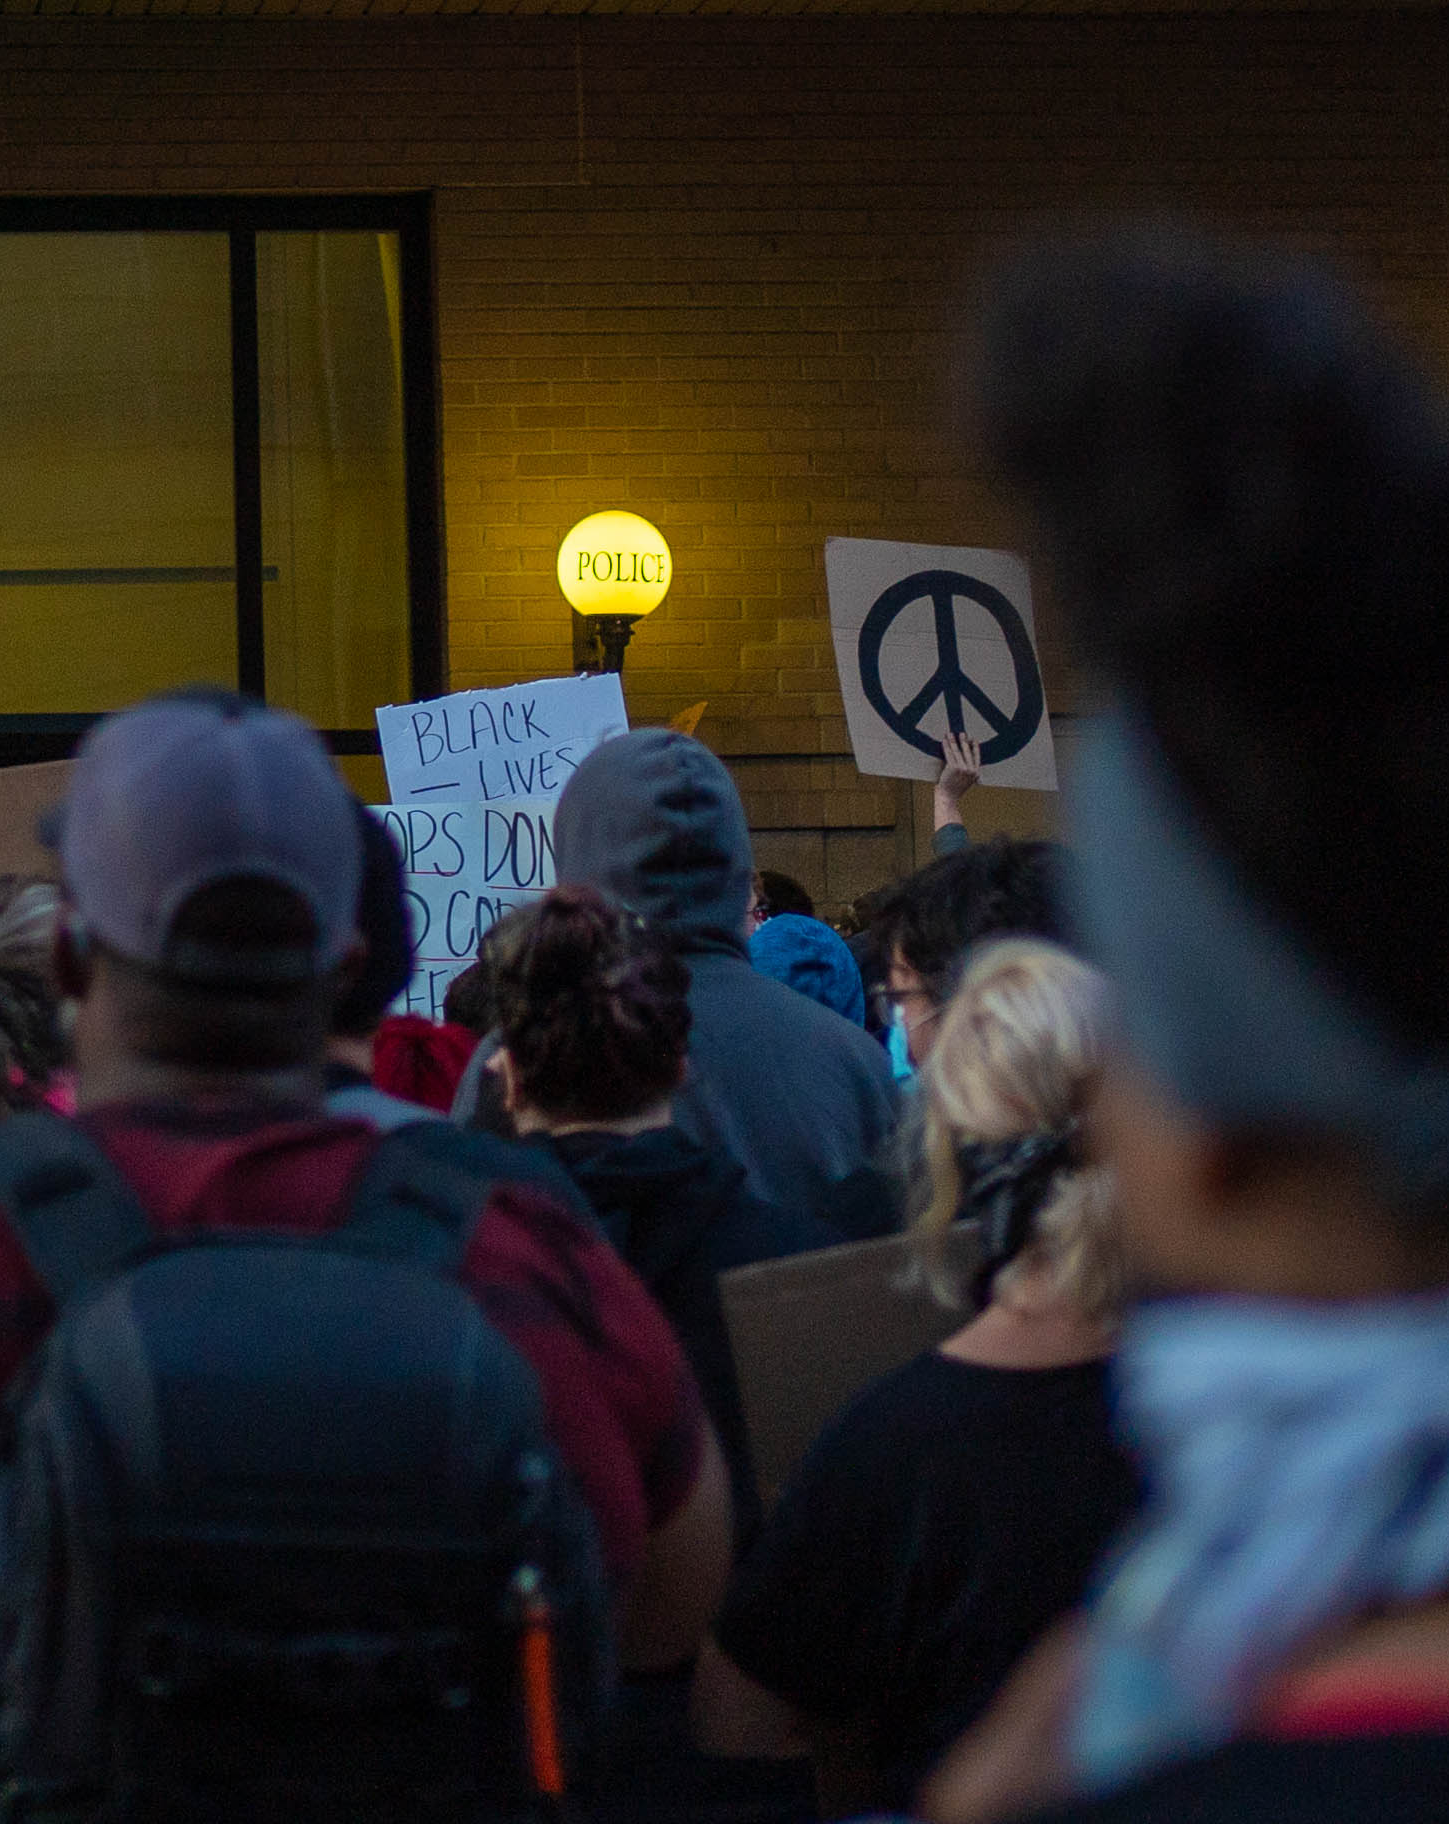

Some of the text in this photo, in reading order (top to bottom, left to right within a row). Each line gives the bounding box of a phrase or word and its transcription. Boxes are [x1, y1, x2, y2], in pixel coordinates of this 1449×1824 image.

[578, 550, 666, 585] POLICE
[410, 698, 551, 767] BLACK
[384, 808, 559, 888] OPS DON
